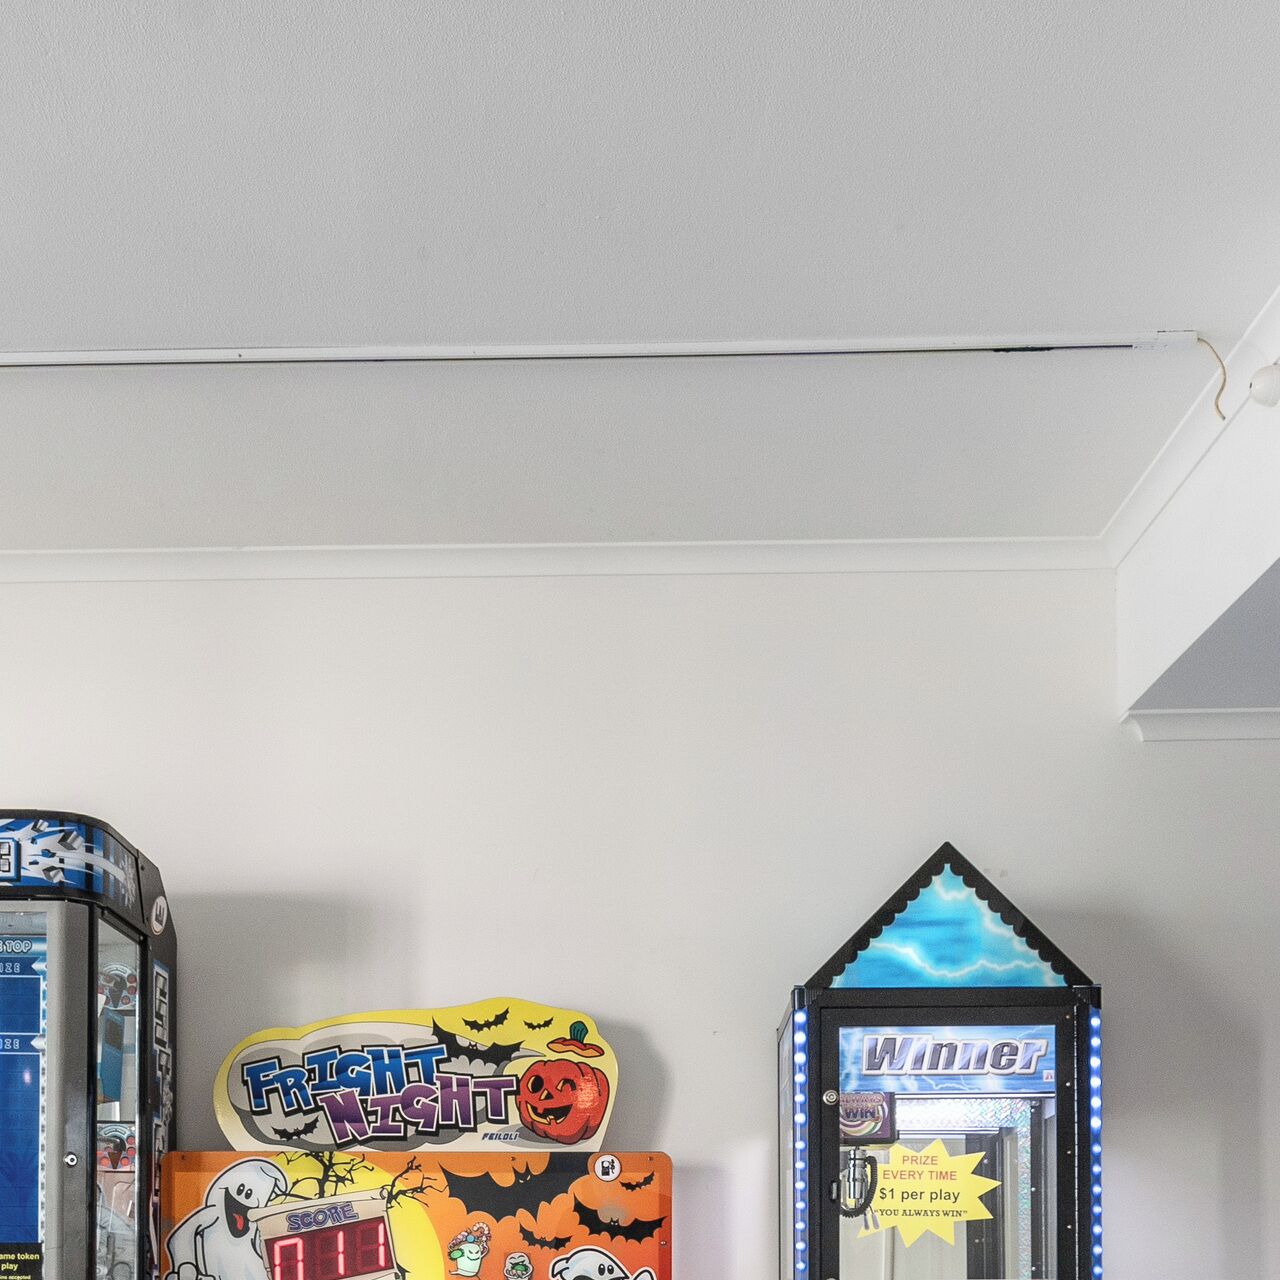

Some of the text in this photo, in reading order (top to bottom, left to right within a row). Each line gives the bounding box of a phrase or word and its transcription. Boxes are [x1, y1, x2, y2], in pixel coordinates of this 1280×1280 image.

[3, 940, 32, 953] TOP
[864, 1034, 1048, 1075] Winner
[241, 1041, 451, 1113] FRIGHT
[318, 1073, 520, 1148] NIGHT
[901, 1155, 938, 1166] PRIZE
[882, 1169, 958, 1182] EVERY TIME
[879, 1186, 961, 1204] $1 per play
[286, 1202, 361, 1234] SCORE
[901, 1208, 940, 1217] ALWAYS
[17, 1252, 40, 1261] token
[1, 1262, 19, 1272] play
